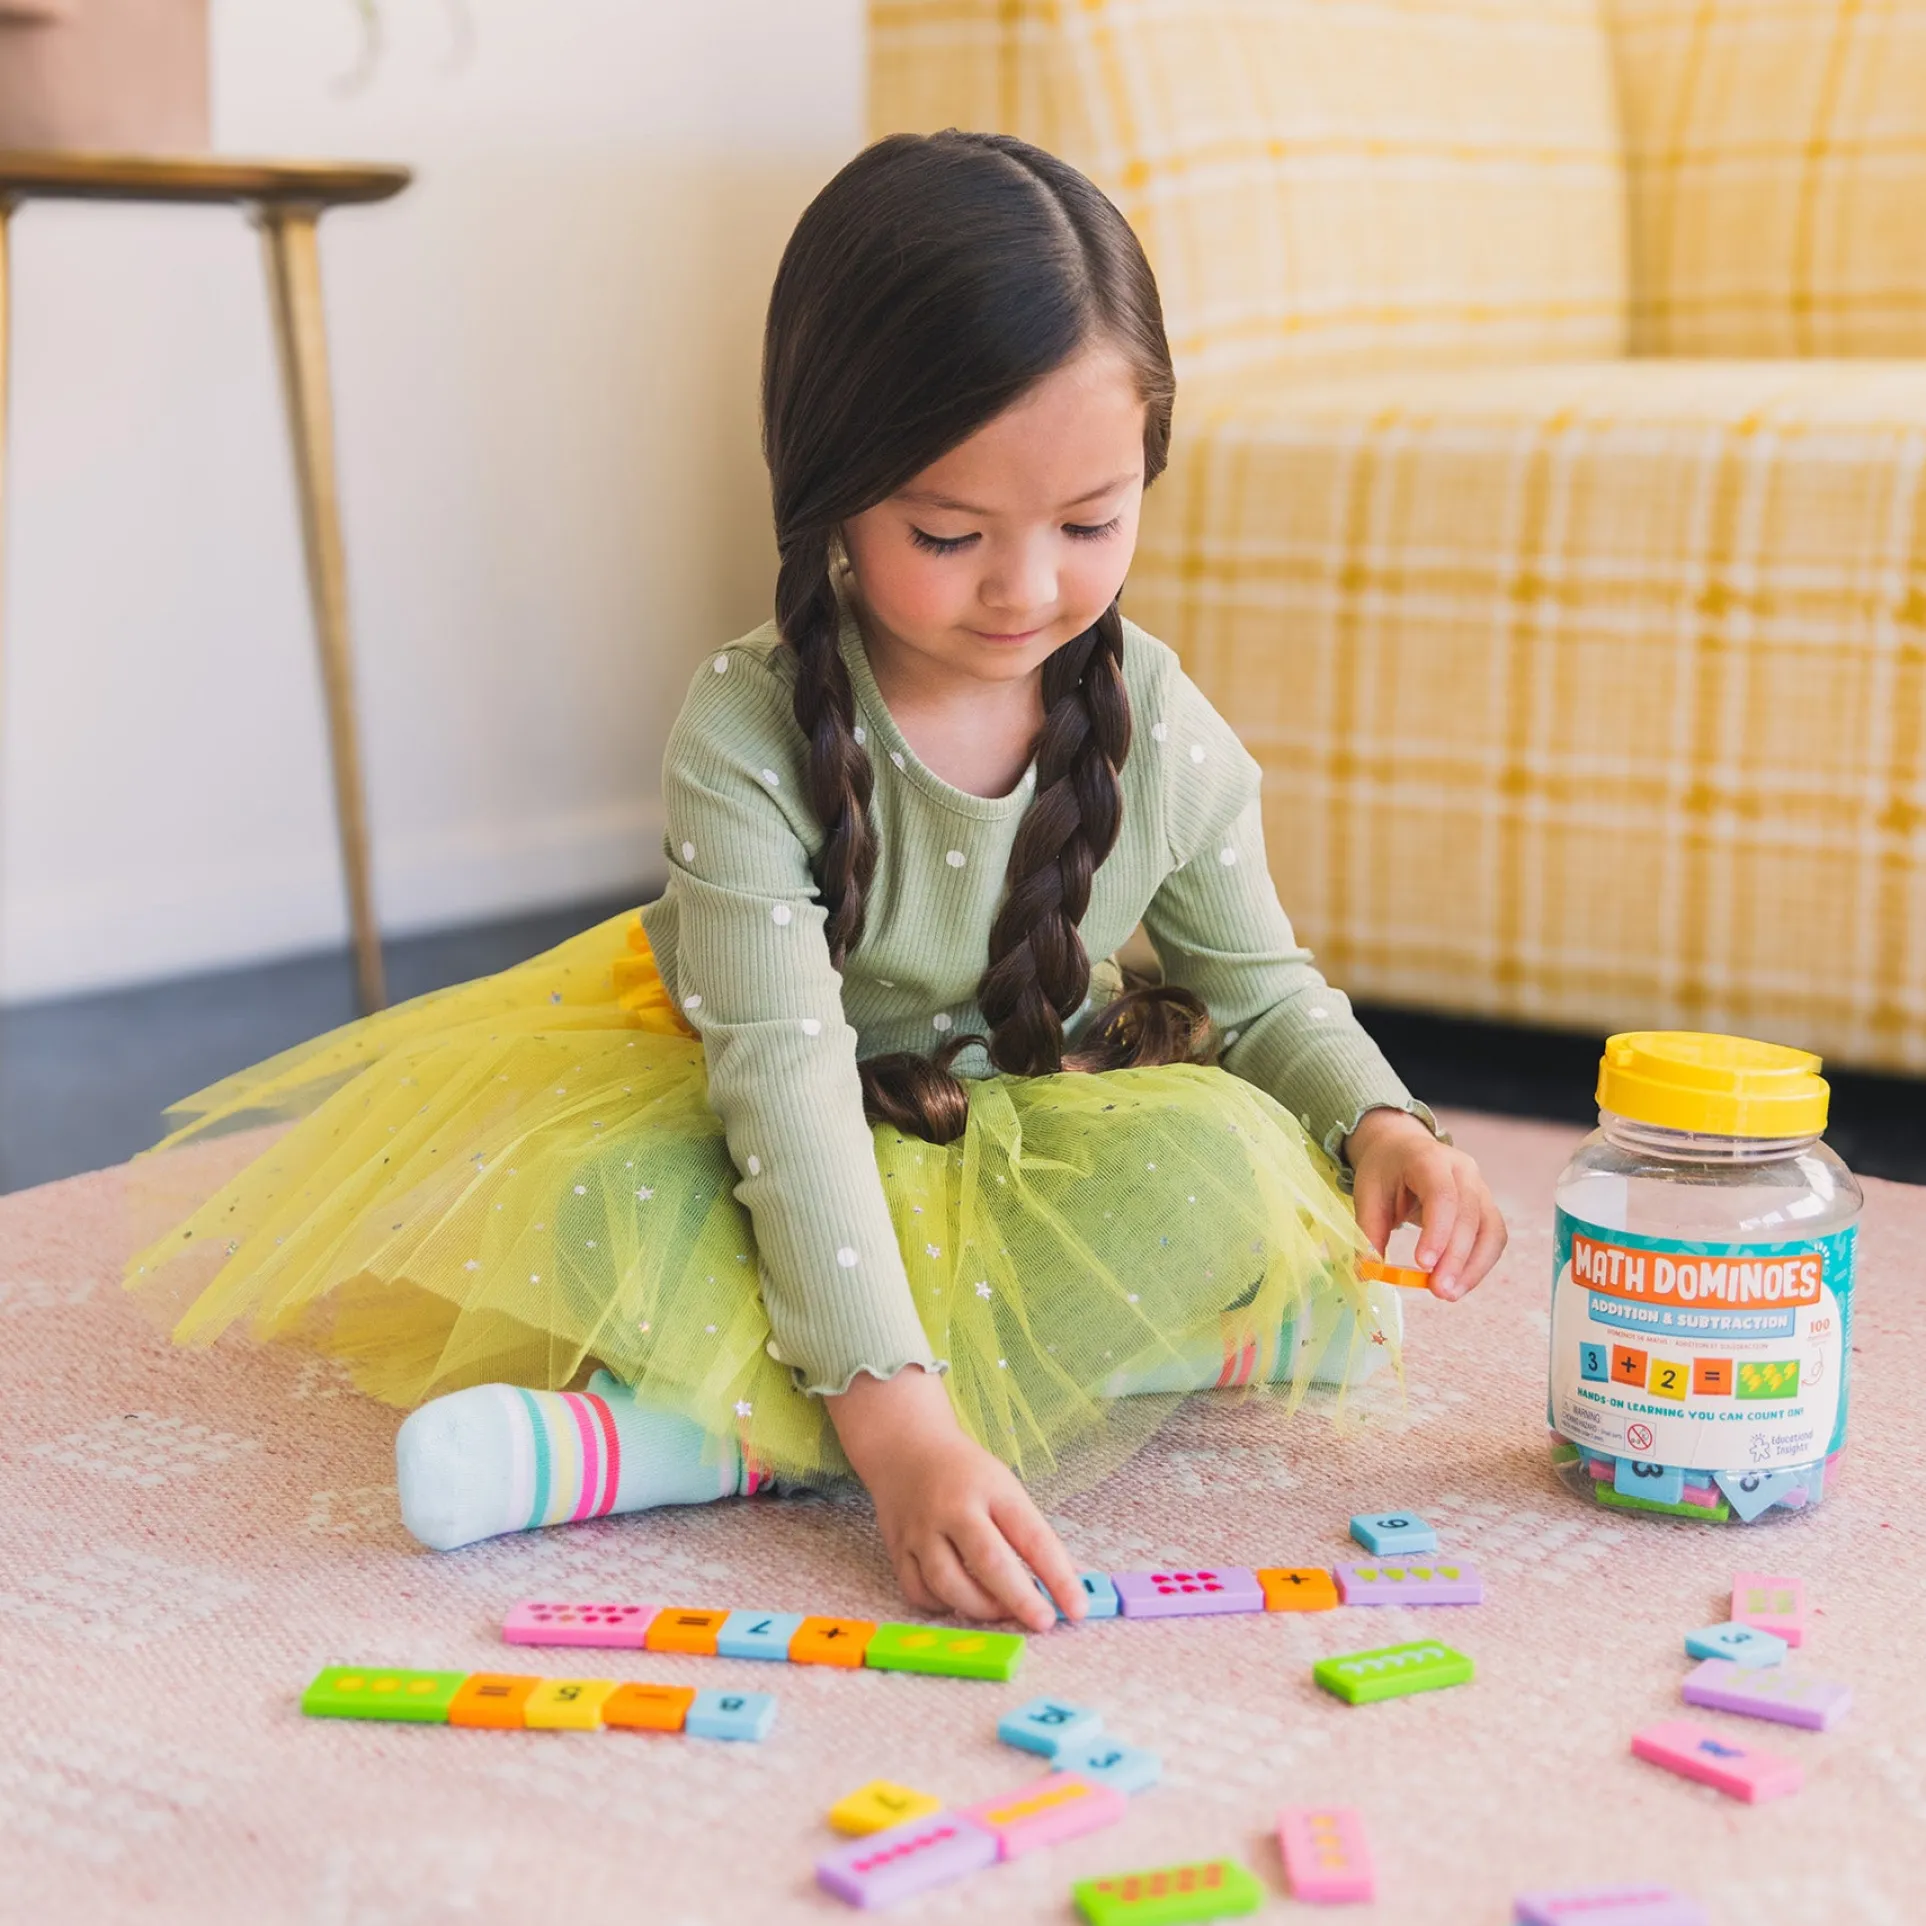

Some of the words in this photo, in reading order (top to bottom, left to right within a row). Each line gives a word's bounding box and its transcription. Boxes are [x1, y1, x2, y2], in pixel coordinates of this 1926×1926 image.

[1575, 1240, 1645, 1293] MATH
[1653, 1257, 1818, 1303] DOMINOES
[1591, 1298, 1659, 1323] ADDITION
[1663, 1312, 1673, 1326] &
[1677, 1314, 1788, 1330] SUBTRACTION
[1810, 1318, 1830, 1333] 100
[1588, 1352, 1598, 1371] 3
[1621, 1357, 1636, 1373] +
[1660, 1370, 1676, 1389] 2
[1705, 1371, 1720, 1381] =
[1577, 1386, 1624, 1408] HANDS-ON
[1627, 1402, 1684, 1418] LEARNING
[1688, 1409, 1715, 1420] YOU
[1719, 1411, 1743, 1420] CAN
[1747, 1410, 1784, 1420] COUNT
[1771, 1428, 1814, 1445] Educational
[1776, 1442, 1808, 1456] Insights
